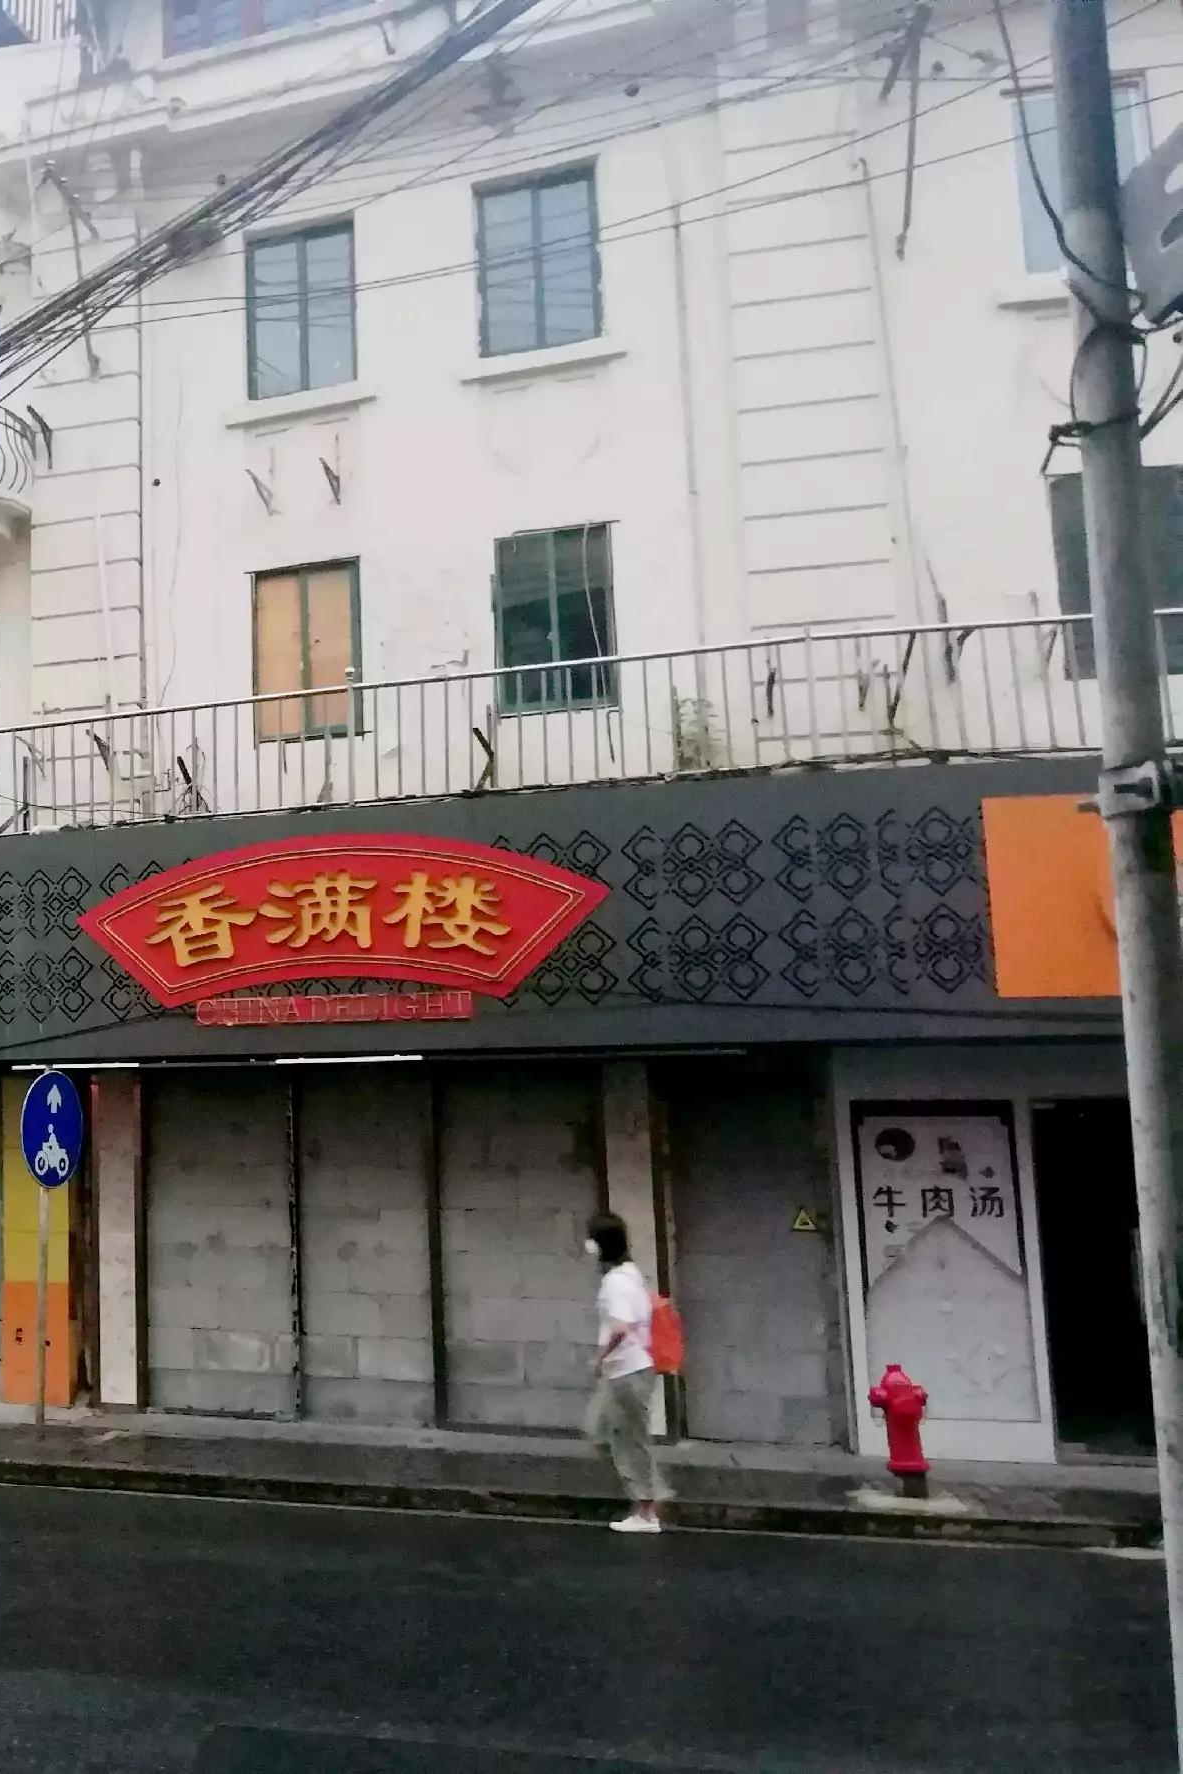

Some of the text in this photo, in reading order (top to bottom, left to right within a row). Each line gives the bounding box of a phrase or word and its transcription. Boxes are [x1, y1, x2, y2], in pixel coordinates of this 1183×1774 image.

[144, 868, 512, 968] 香满楼
[196, 998, 300, 1027] CHINA
[872, 1185, 1005, 1218] 牛肉汤
